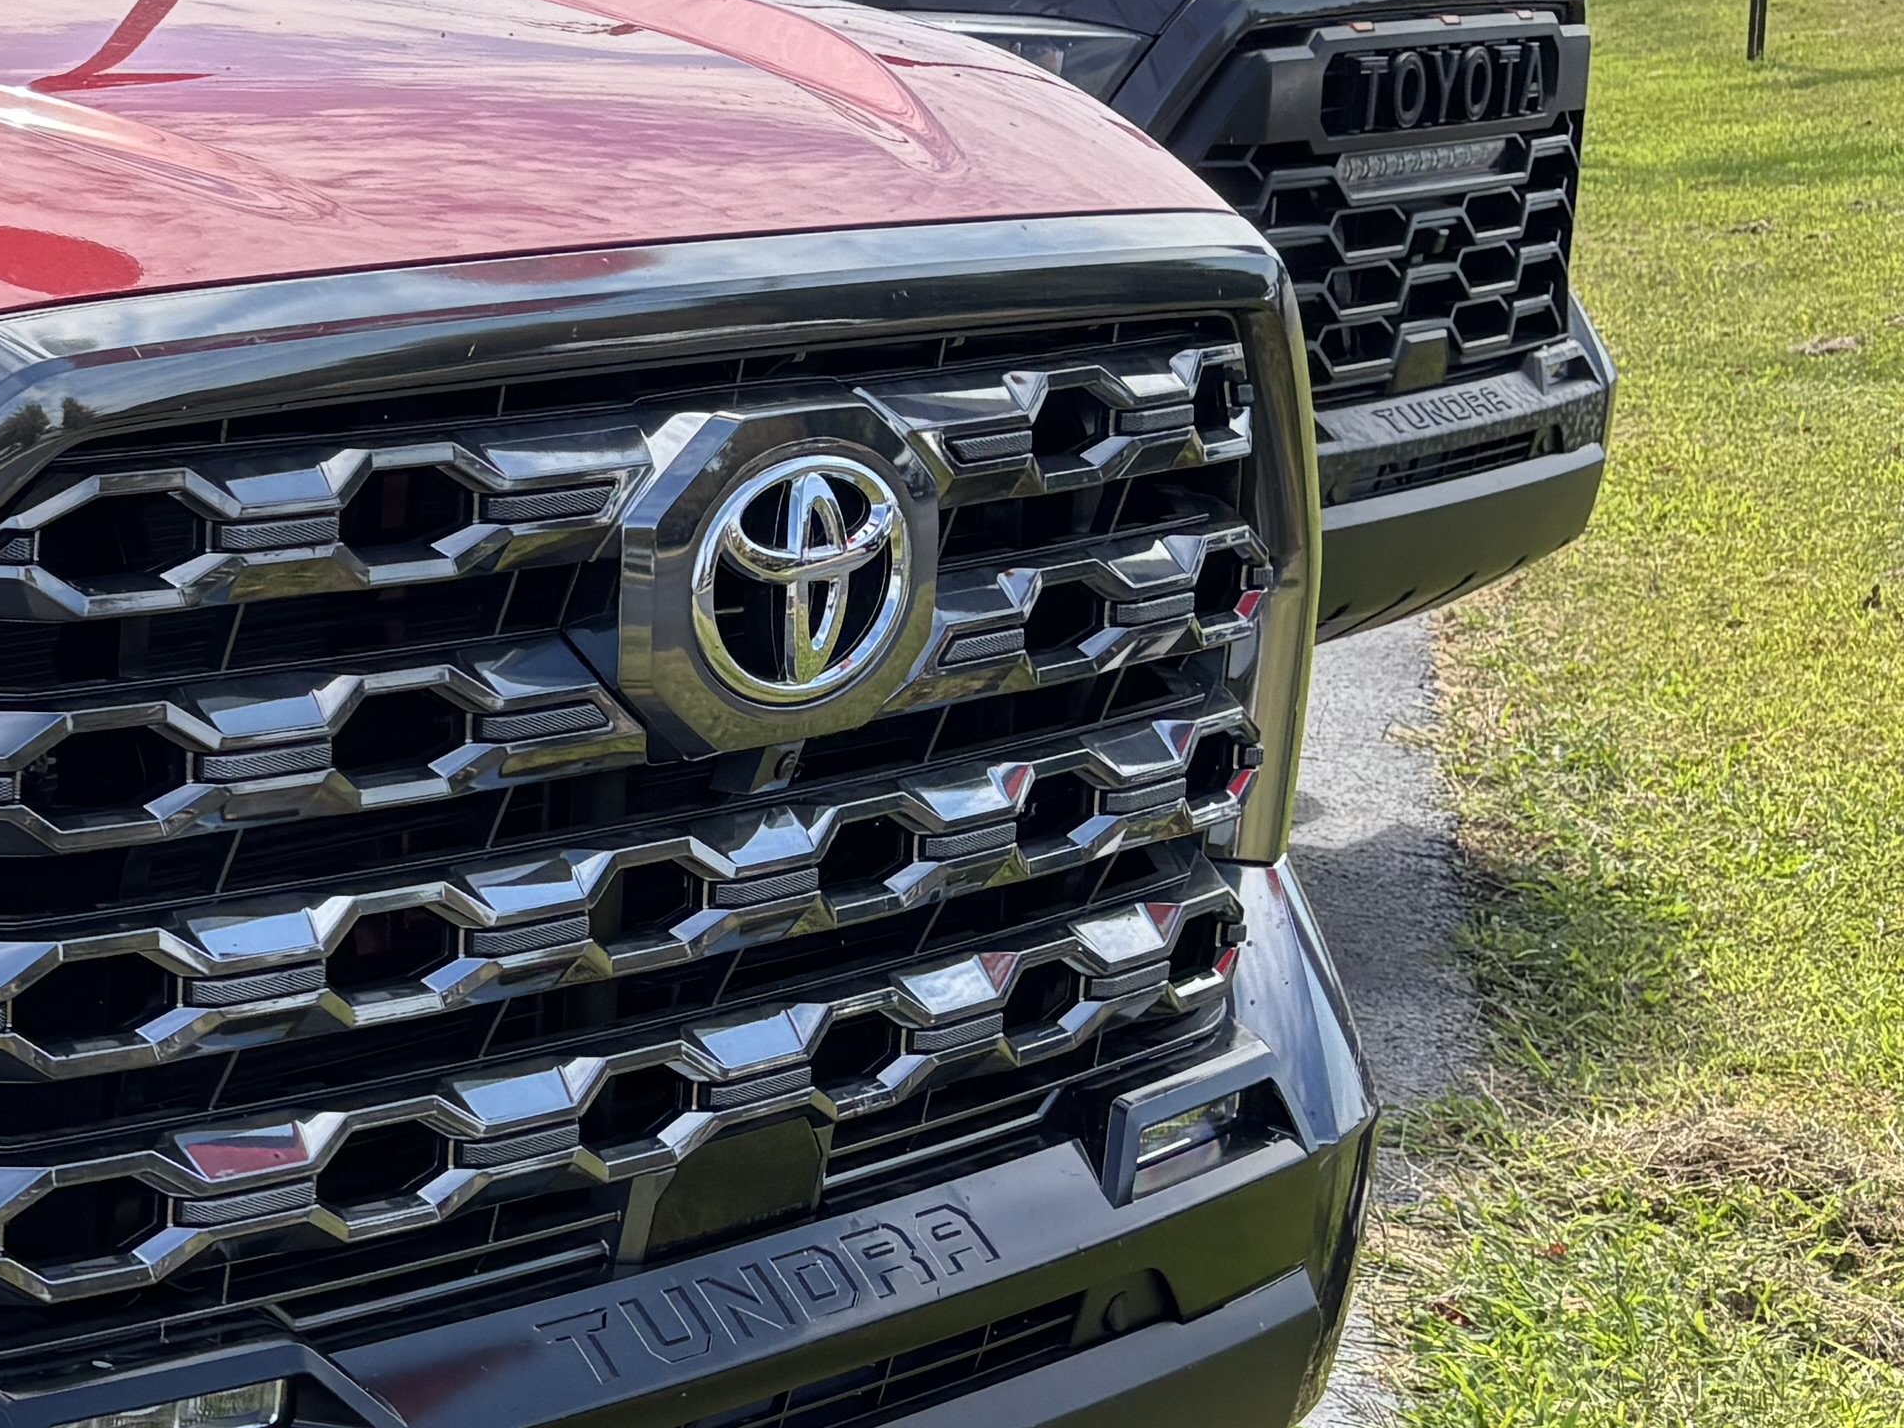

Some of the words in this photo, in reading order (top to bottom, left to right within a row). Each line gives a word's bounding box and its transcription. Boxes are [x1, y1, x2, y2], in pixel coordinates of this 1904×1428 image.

[1355, 41, 1545, 131] TOYOTA
[1371, 387, 1512, 434] TUNDRA
[533, 1203, 1001, 1384] TUNDRA
